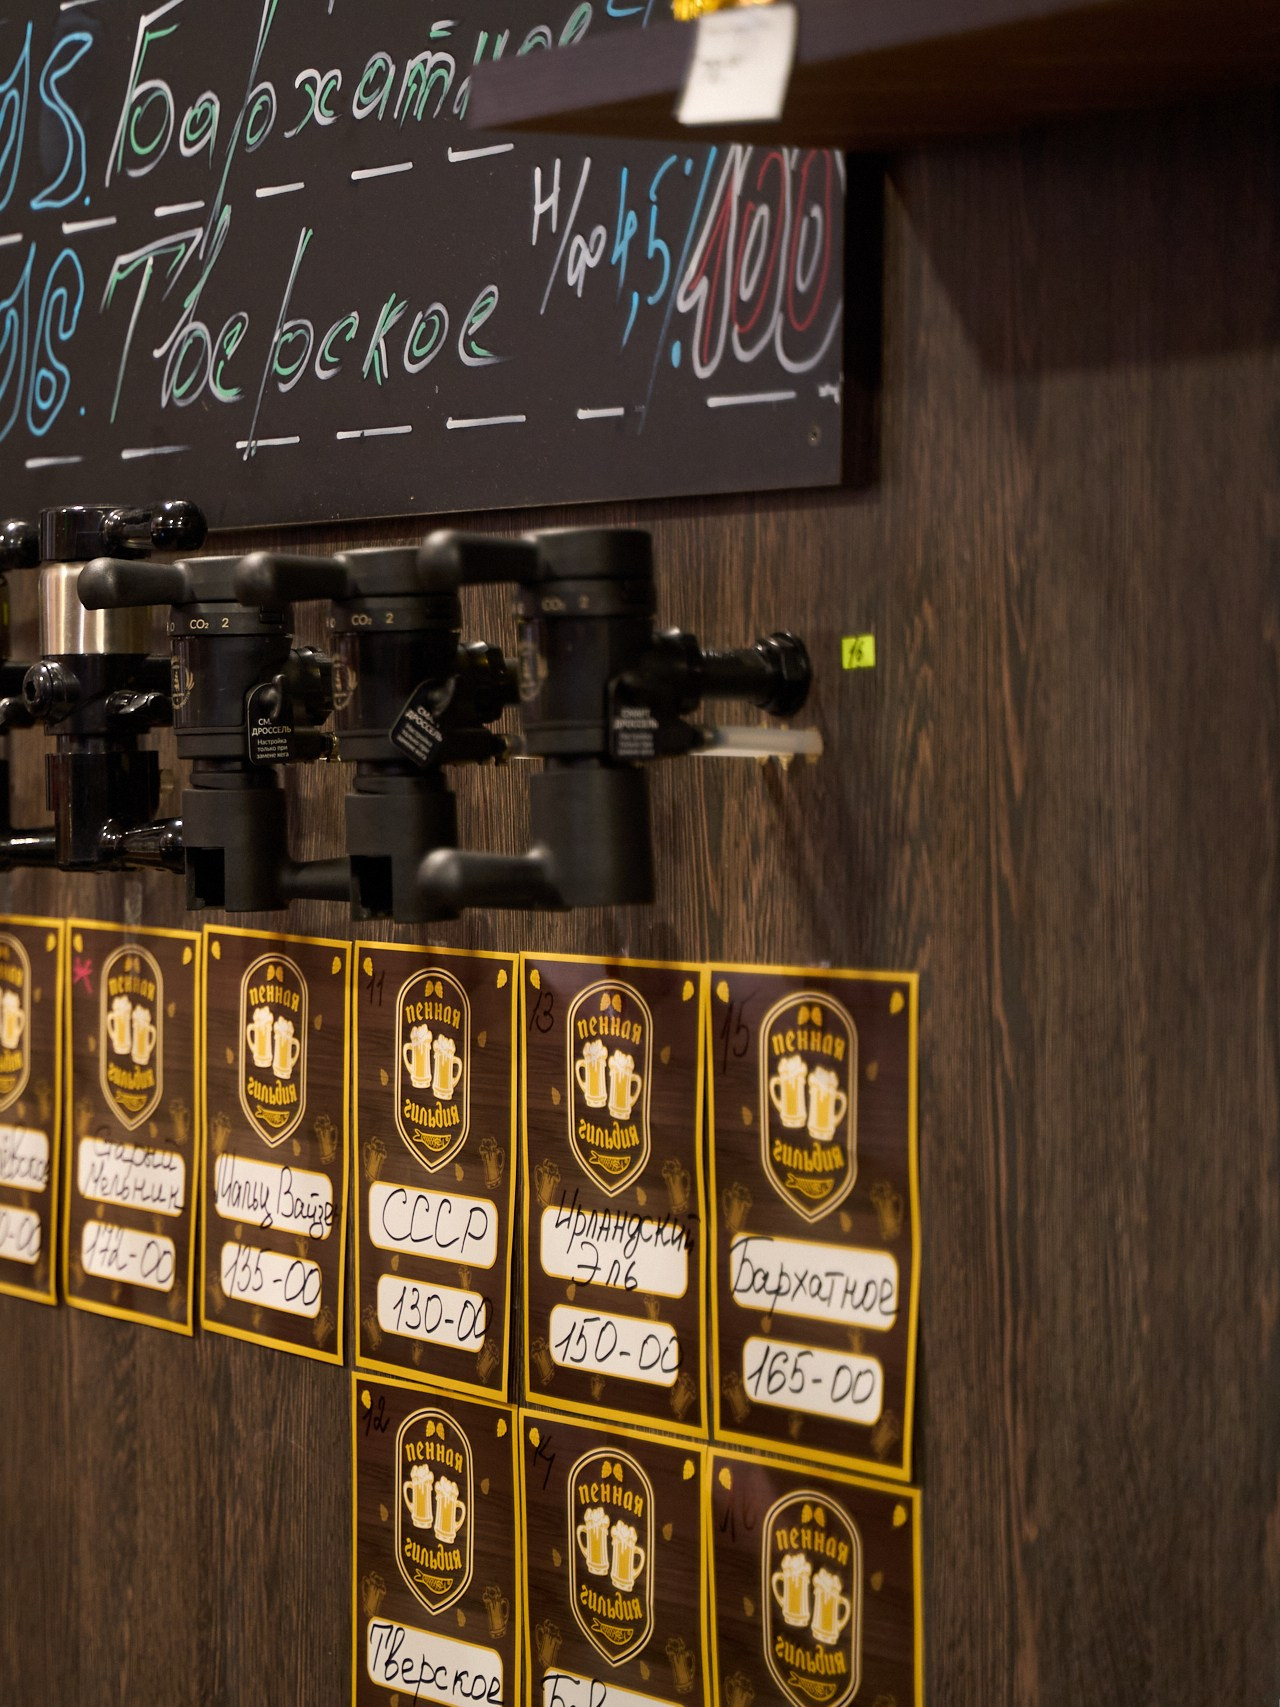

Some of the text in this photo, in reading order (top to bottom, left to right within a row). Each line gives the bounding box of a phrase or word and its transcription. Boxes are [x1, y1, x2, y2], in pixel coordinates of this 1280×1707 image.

[100, 205, 503, 460] Тверское
[221, 617, 230, 628] 2
[251, 726, 292, 736] ДРОССЕЛЬ
[405, 1001, 462, 1030] пенная
[577, 1015, 643, 1048] пенная
[382, 1188, 488, 1253] СССР
[224, 1243, 322, 1306] 135-00
[571, 1241, 638, 1292] Эль
[730, 1236, 899, 1318] Бархатное
[393, 1286, 494, 1342] 130-00
[555, 1316, 684, 1374] 150-00
[747, 1345, 876, 1404] 165-00
[405, 1439, 463, 1475] пенная
[578, 1480, 645, 1518] пенная
[370, 1623, 504, 1707] Тверское
